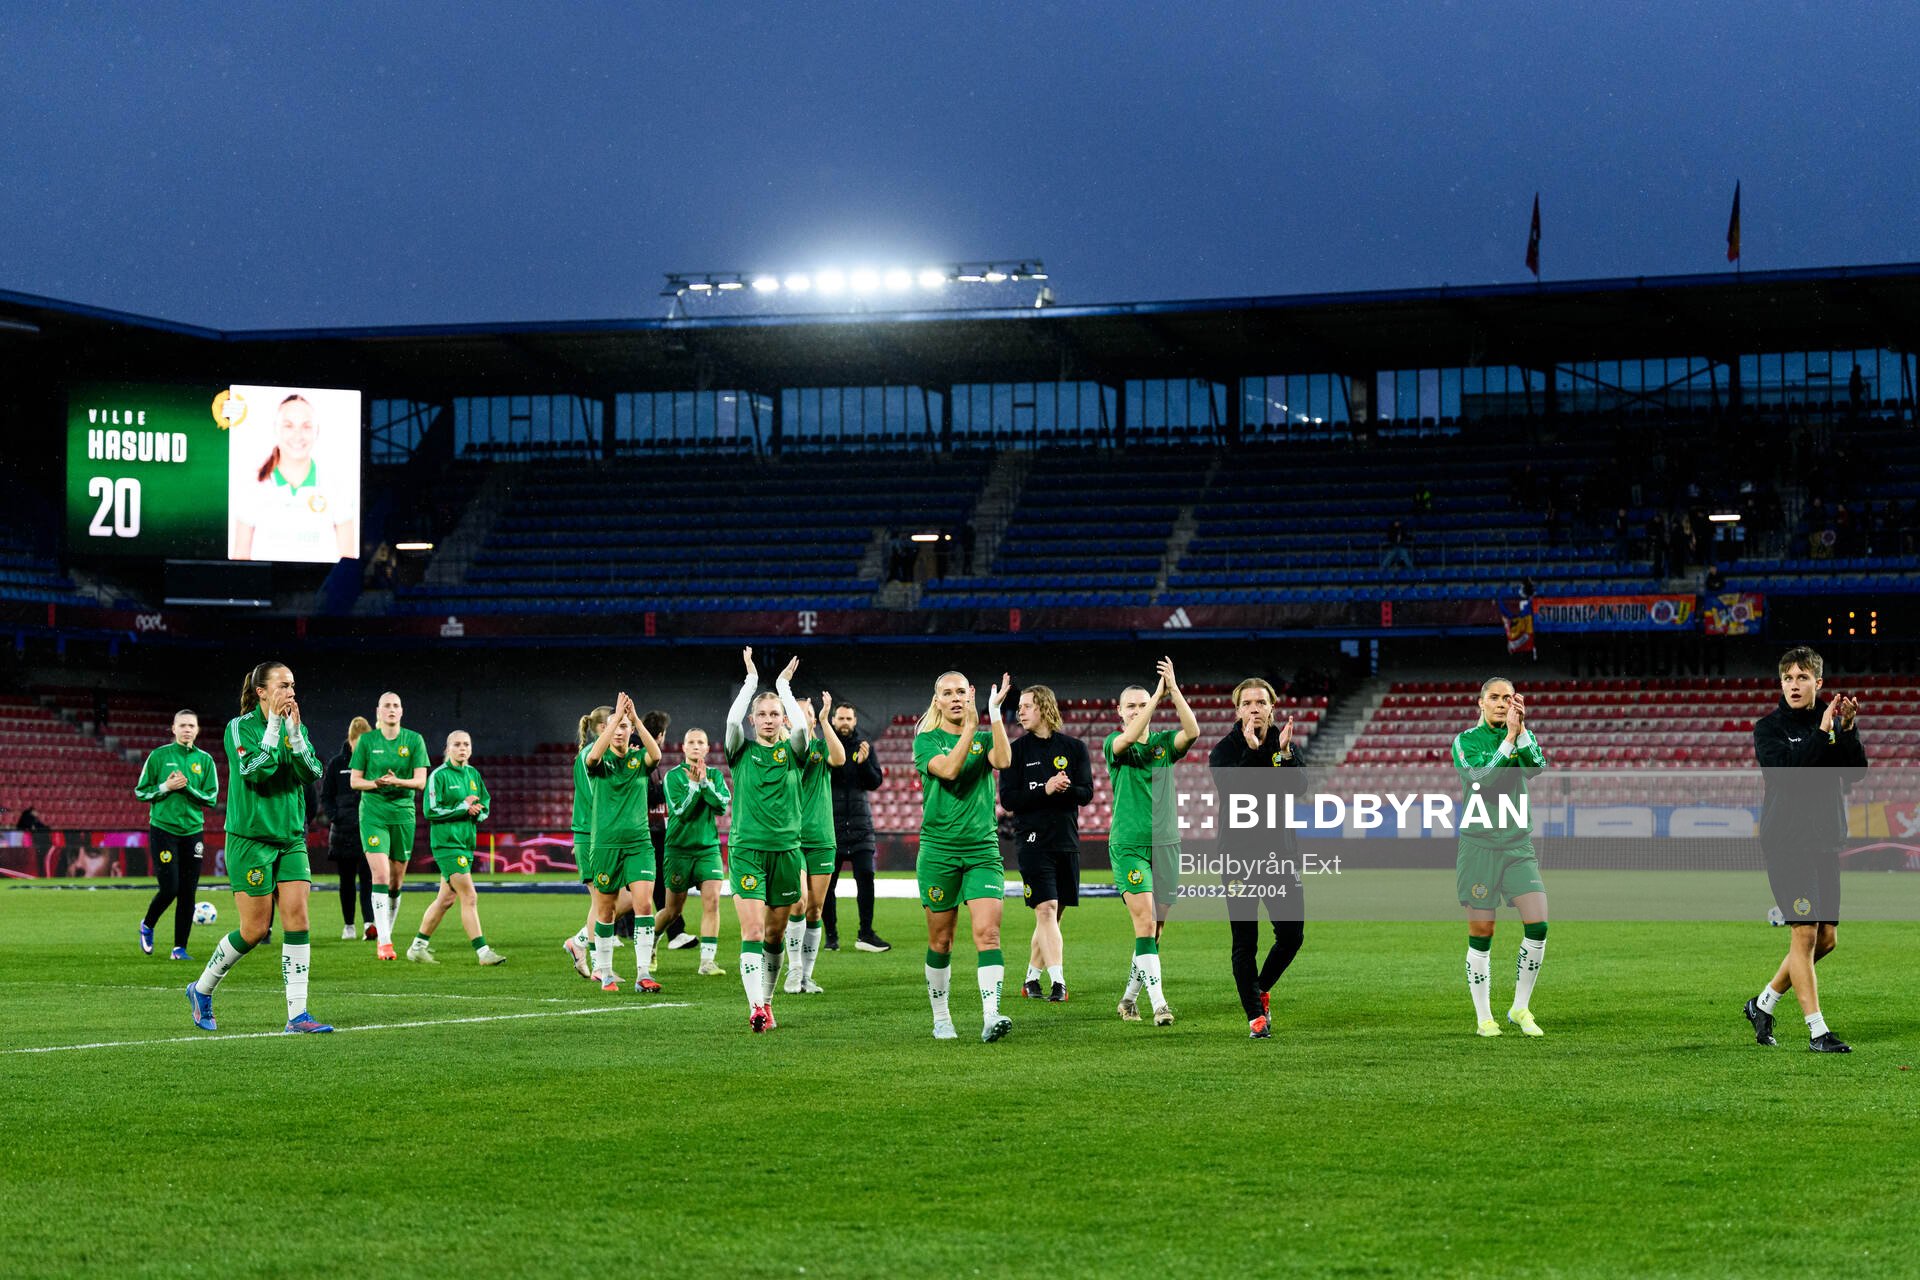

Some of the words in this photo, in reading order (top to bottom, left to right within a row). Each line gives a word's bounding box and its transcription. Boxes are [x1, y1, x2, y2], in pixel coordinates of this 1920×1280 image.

[88, 408, 146, 426] VILDE
[88, 429, 188, 463] HASUND
[88, 476, 142, 538] 20
[1599, 603, 1614, 623] ON
[1615, 602, 1647, 622] TOUR
